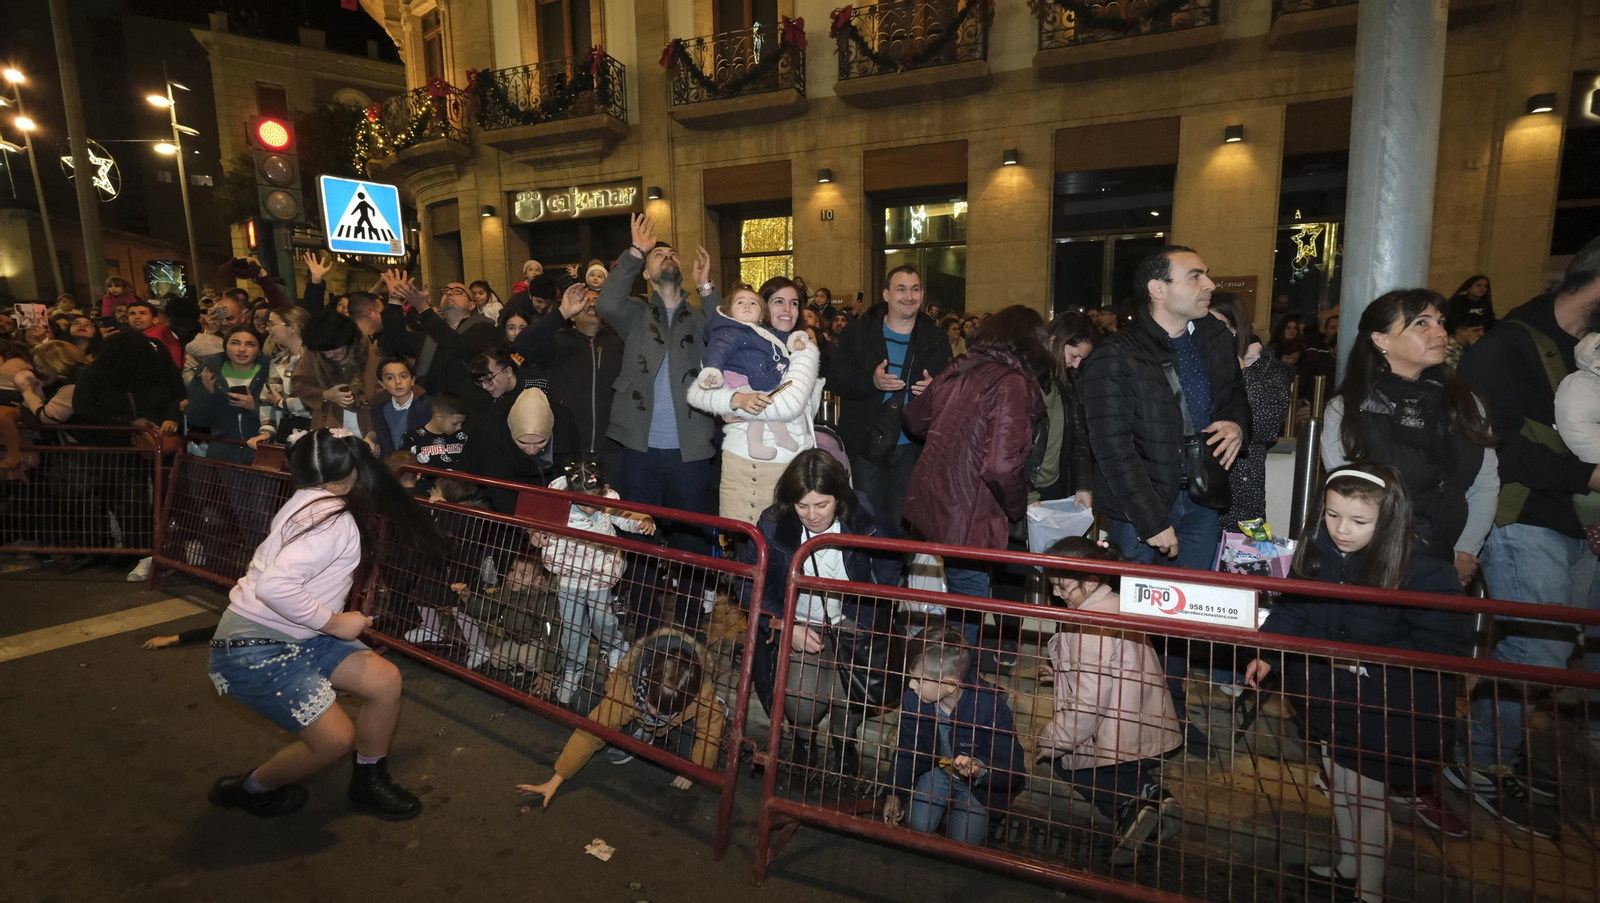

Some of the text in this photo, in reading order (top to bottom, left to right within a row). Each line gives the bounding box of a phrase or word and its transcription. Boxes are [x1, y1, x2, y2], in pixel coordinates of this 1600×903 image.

[547, 186, 635, 217] cajamar
[822, 209, 833, 220] 10
[1215, 280, 1245, 289] ajmar
[1189, 603, 1203, 611] 958
[1205, 605, 1215, 613] 51
[1216, 606, 1227, 614] 51
